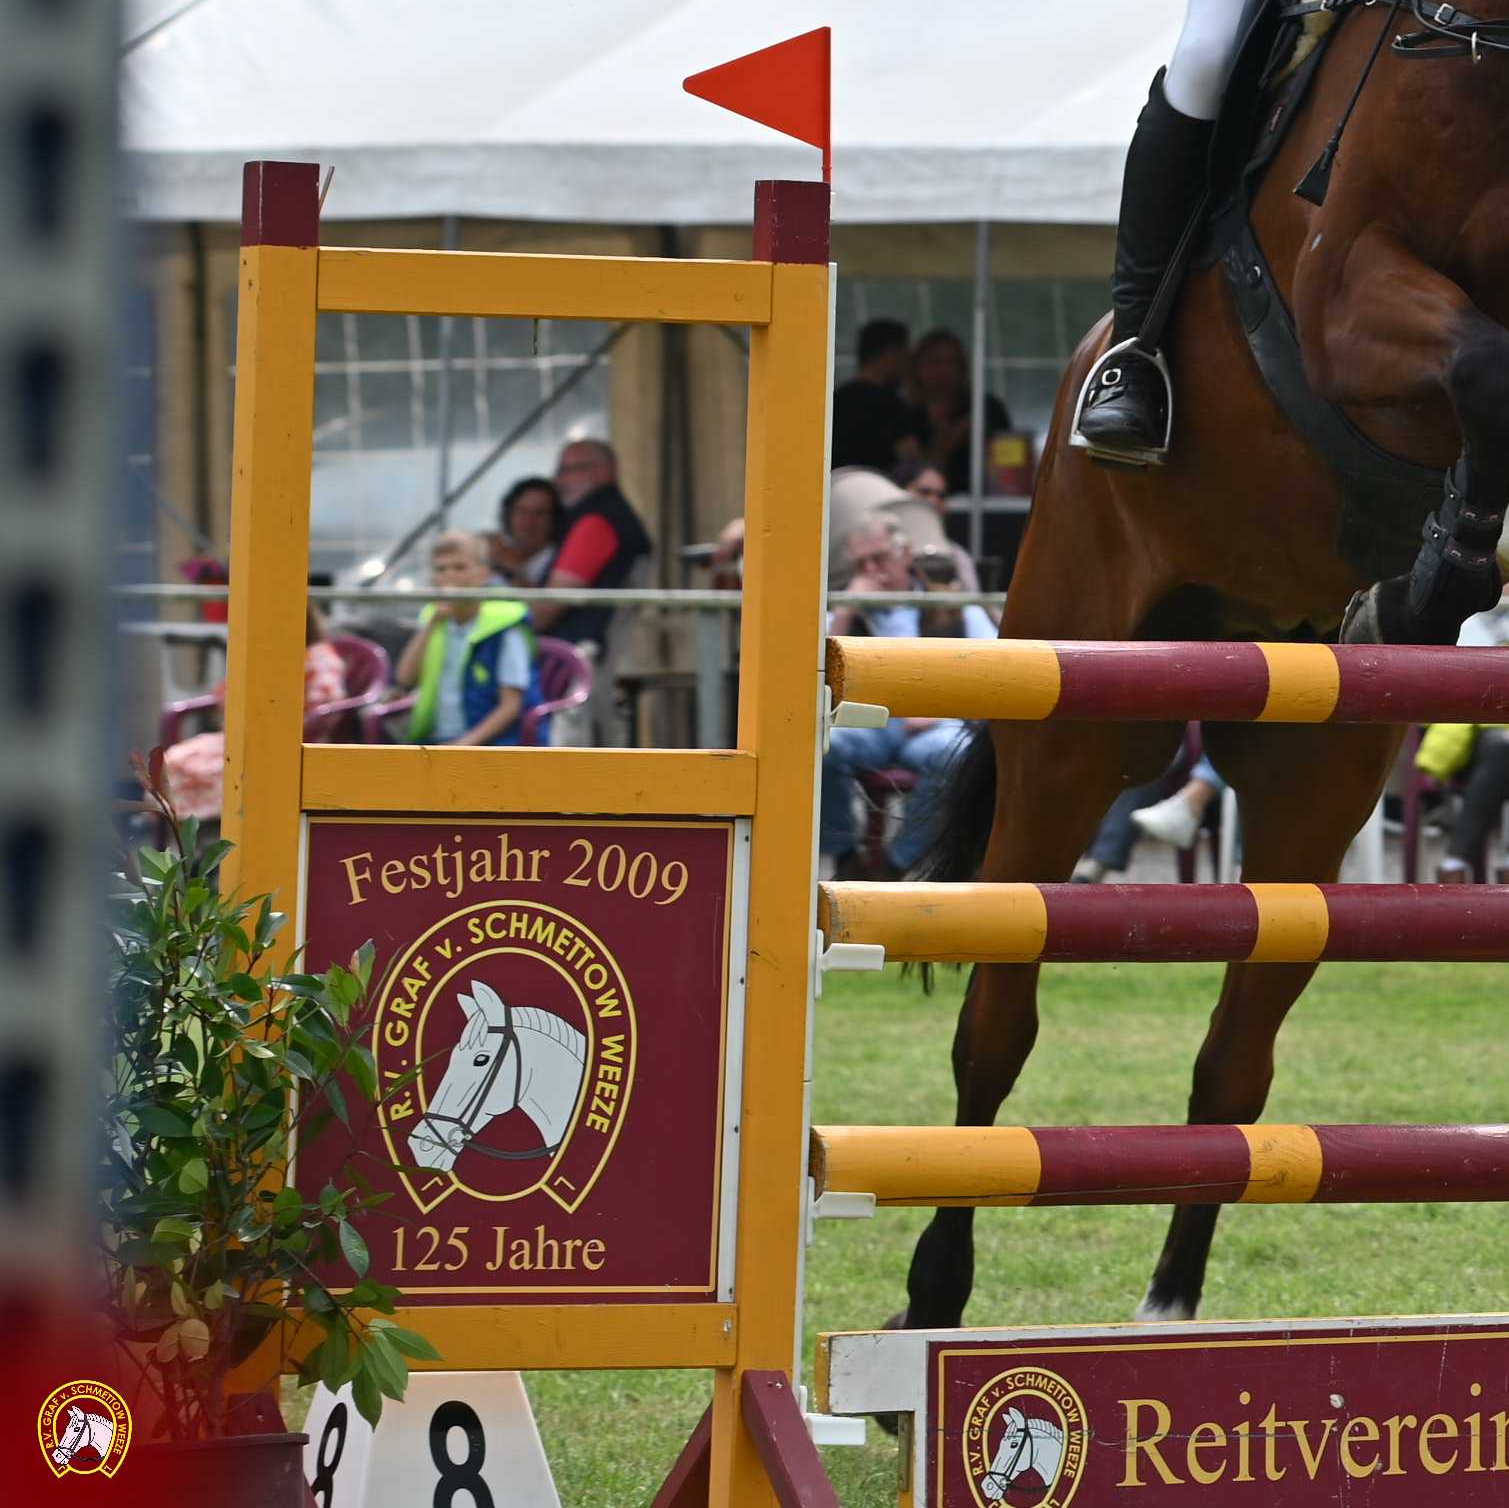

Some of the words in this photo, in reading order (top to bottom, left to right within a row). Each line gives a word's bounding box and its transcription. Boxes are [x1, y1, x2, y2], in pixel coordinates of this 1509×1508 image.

[339, 833, 550, 906] Festjahr
[563, 838, 689, 905] 2009
[384, 955, 433, 1047] GRAF
[434, 938, 463, 959] v.
[467, 912, 623, 1019] SCHMETTOW
[585, 1034, 626, 1133] WEEZE
[391, 1225, 471, 1271] 125
[485, 1224, 607, 1271] Jahre
[969, 1397, 992, 1440] GRAF
[1006, 1373, 1080, 1423] SCHMETTOW
[1063, 1430, 1081, 1478] WEEZE
